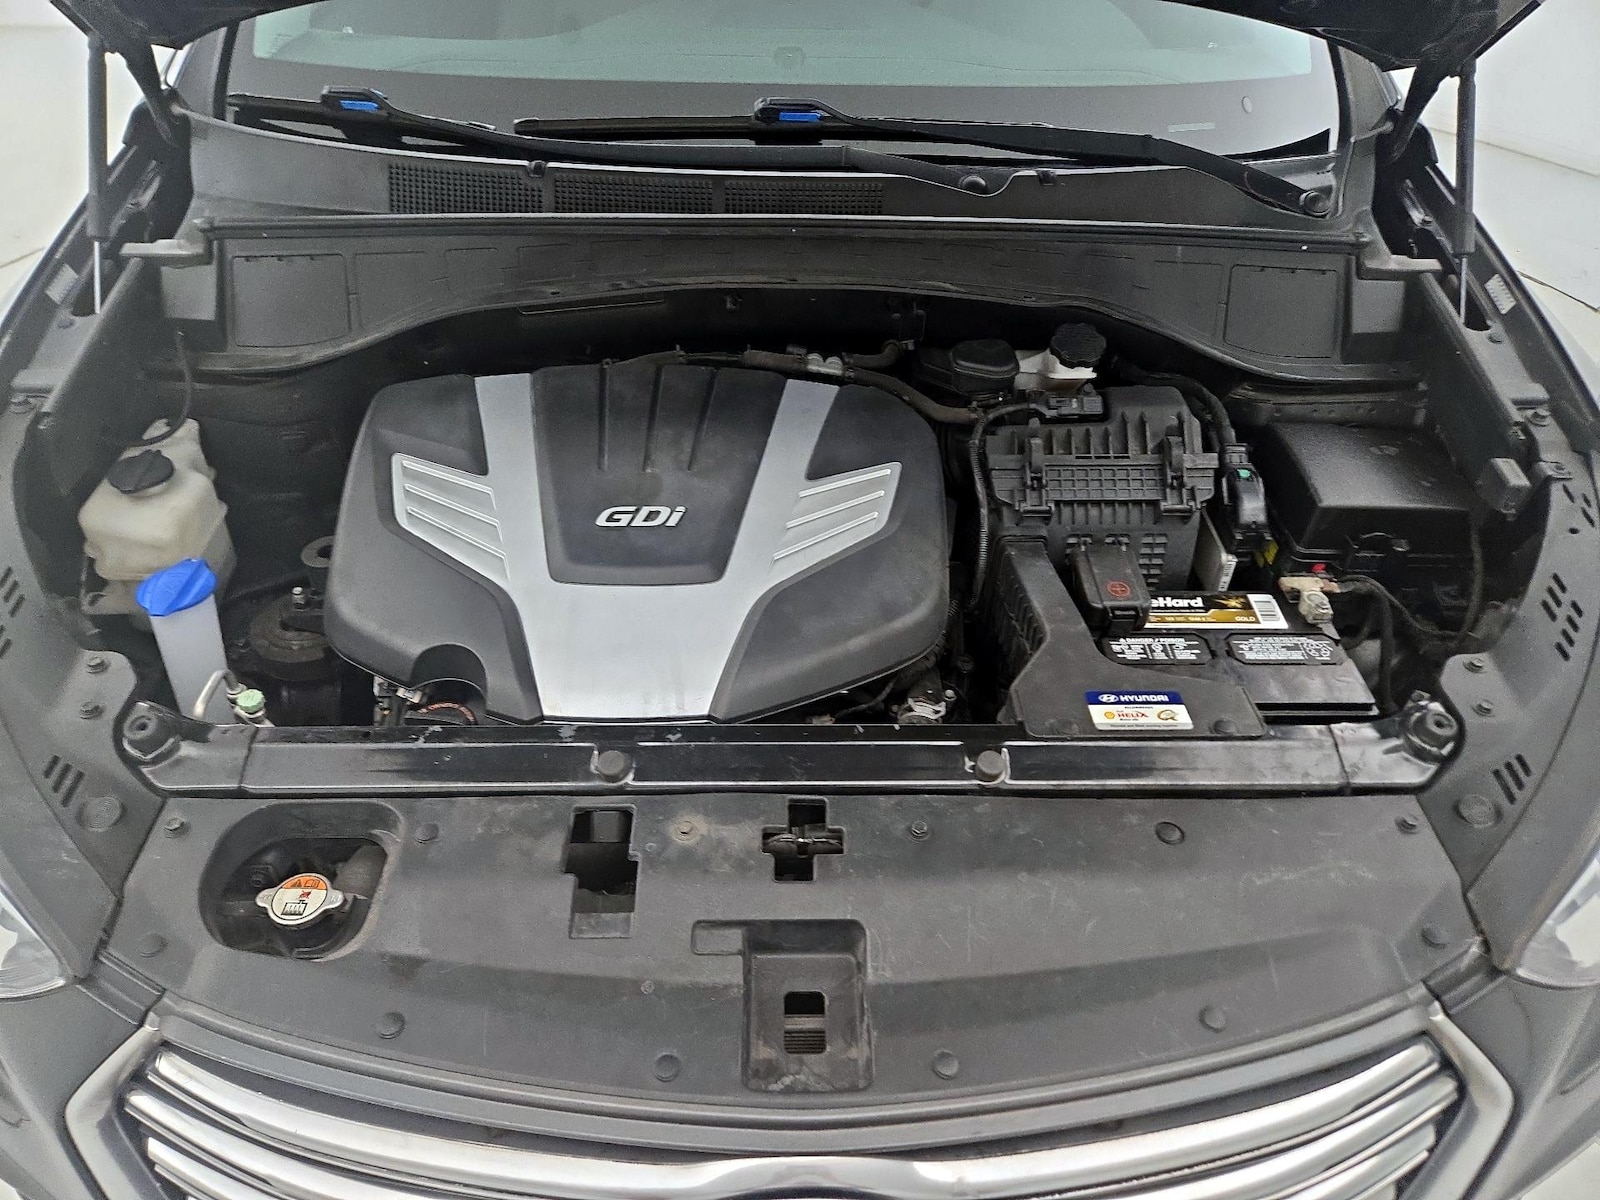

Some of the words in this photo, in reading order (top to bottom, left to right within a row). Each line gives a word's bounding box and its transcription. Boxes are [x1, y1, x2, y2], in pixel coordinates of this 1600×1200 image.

[595, 506, 686, 527] GDi
[1150, 597, 1204, 608] eHard
[1119, 694, 1170, 702] HYUNDAI
